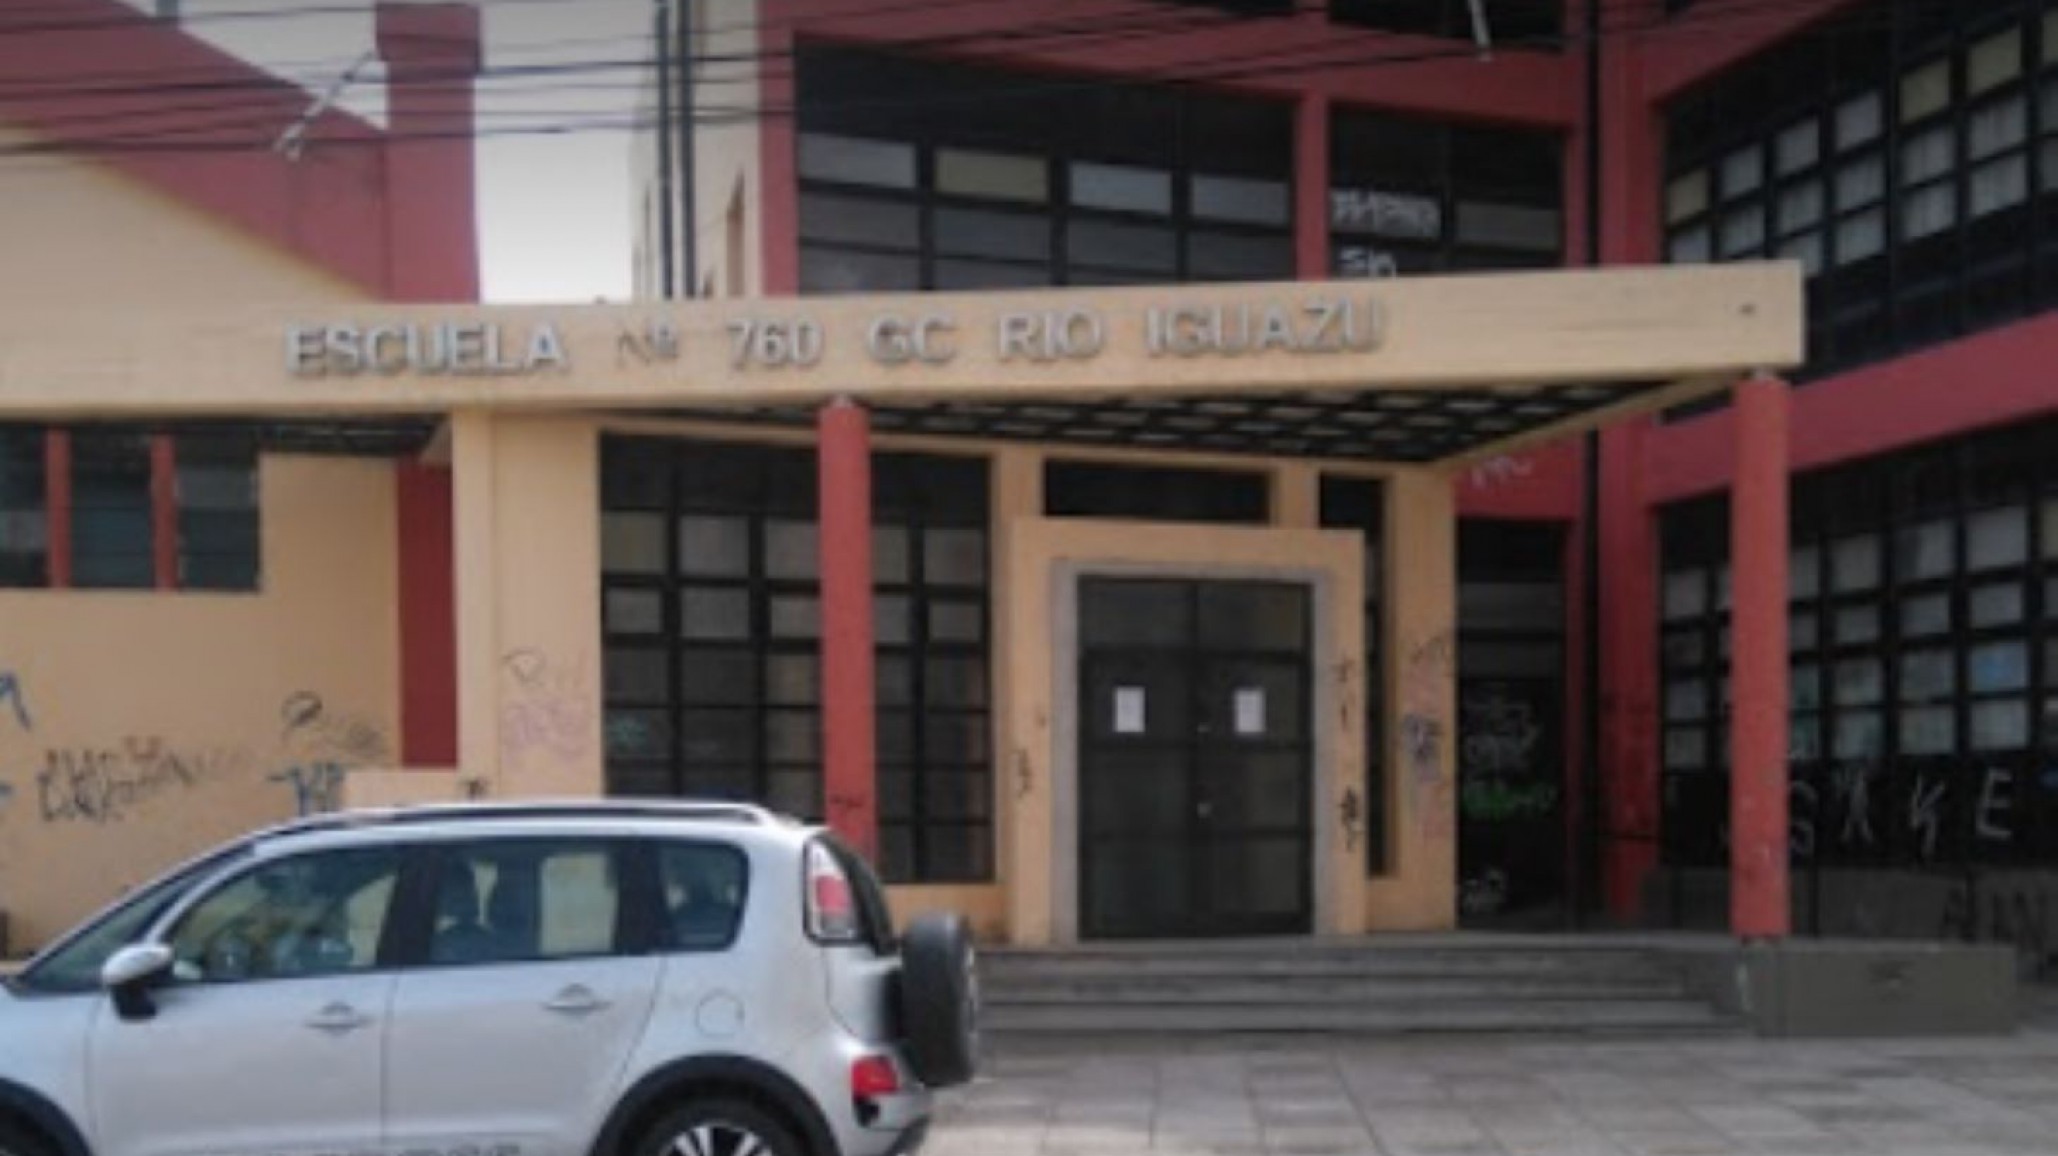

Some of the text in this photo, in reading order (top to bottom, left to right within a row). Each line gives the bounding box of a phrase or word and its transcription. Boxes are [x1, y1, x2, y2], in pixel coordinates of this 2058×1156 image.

[285, 322, 568, 377] ESCUELA
[726, 317, 824, 370] 760
[868, 314, 957, 366] GC
[999, 306, 1102, 363] RIO
[1146, 300, 1387, 356] IGUAZU
